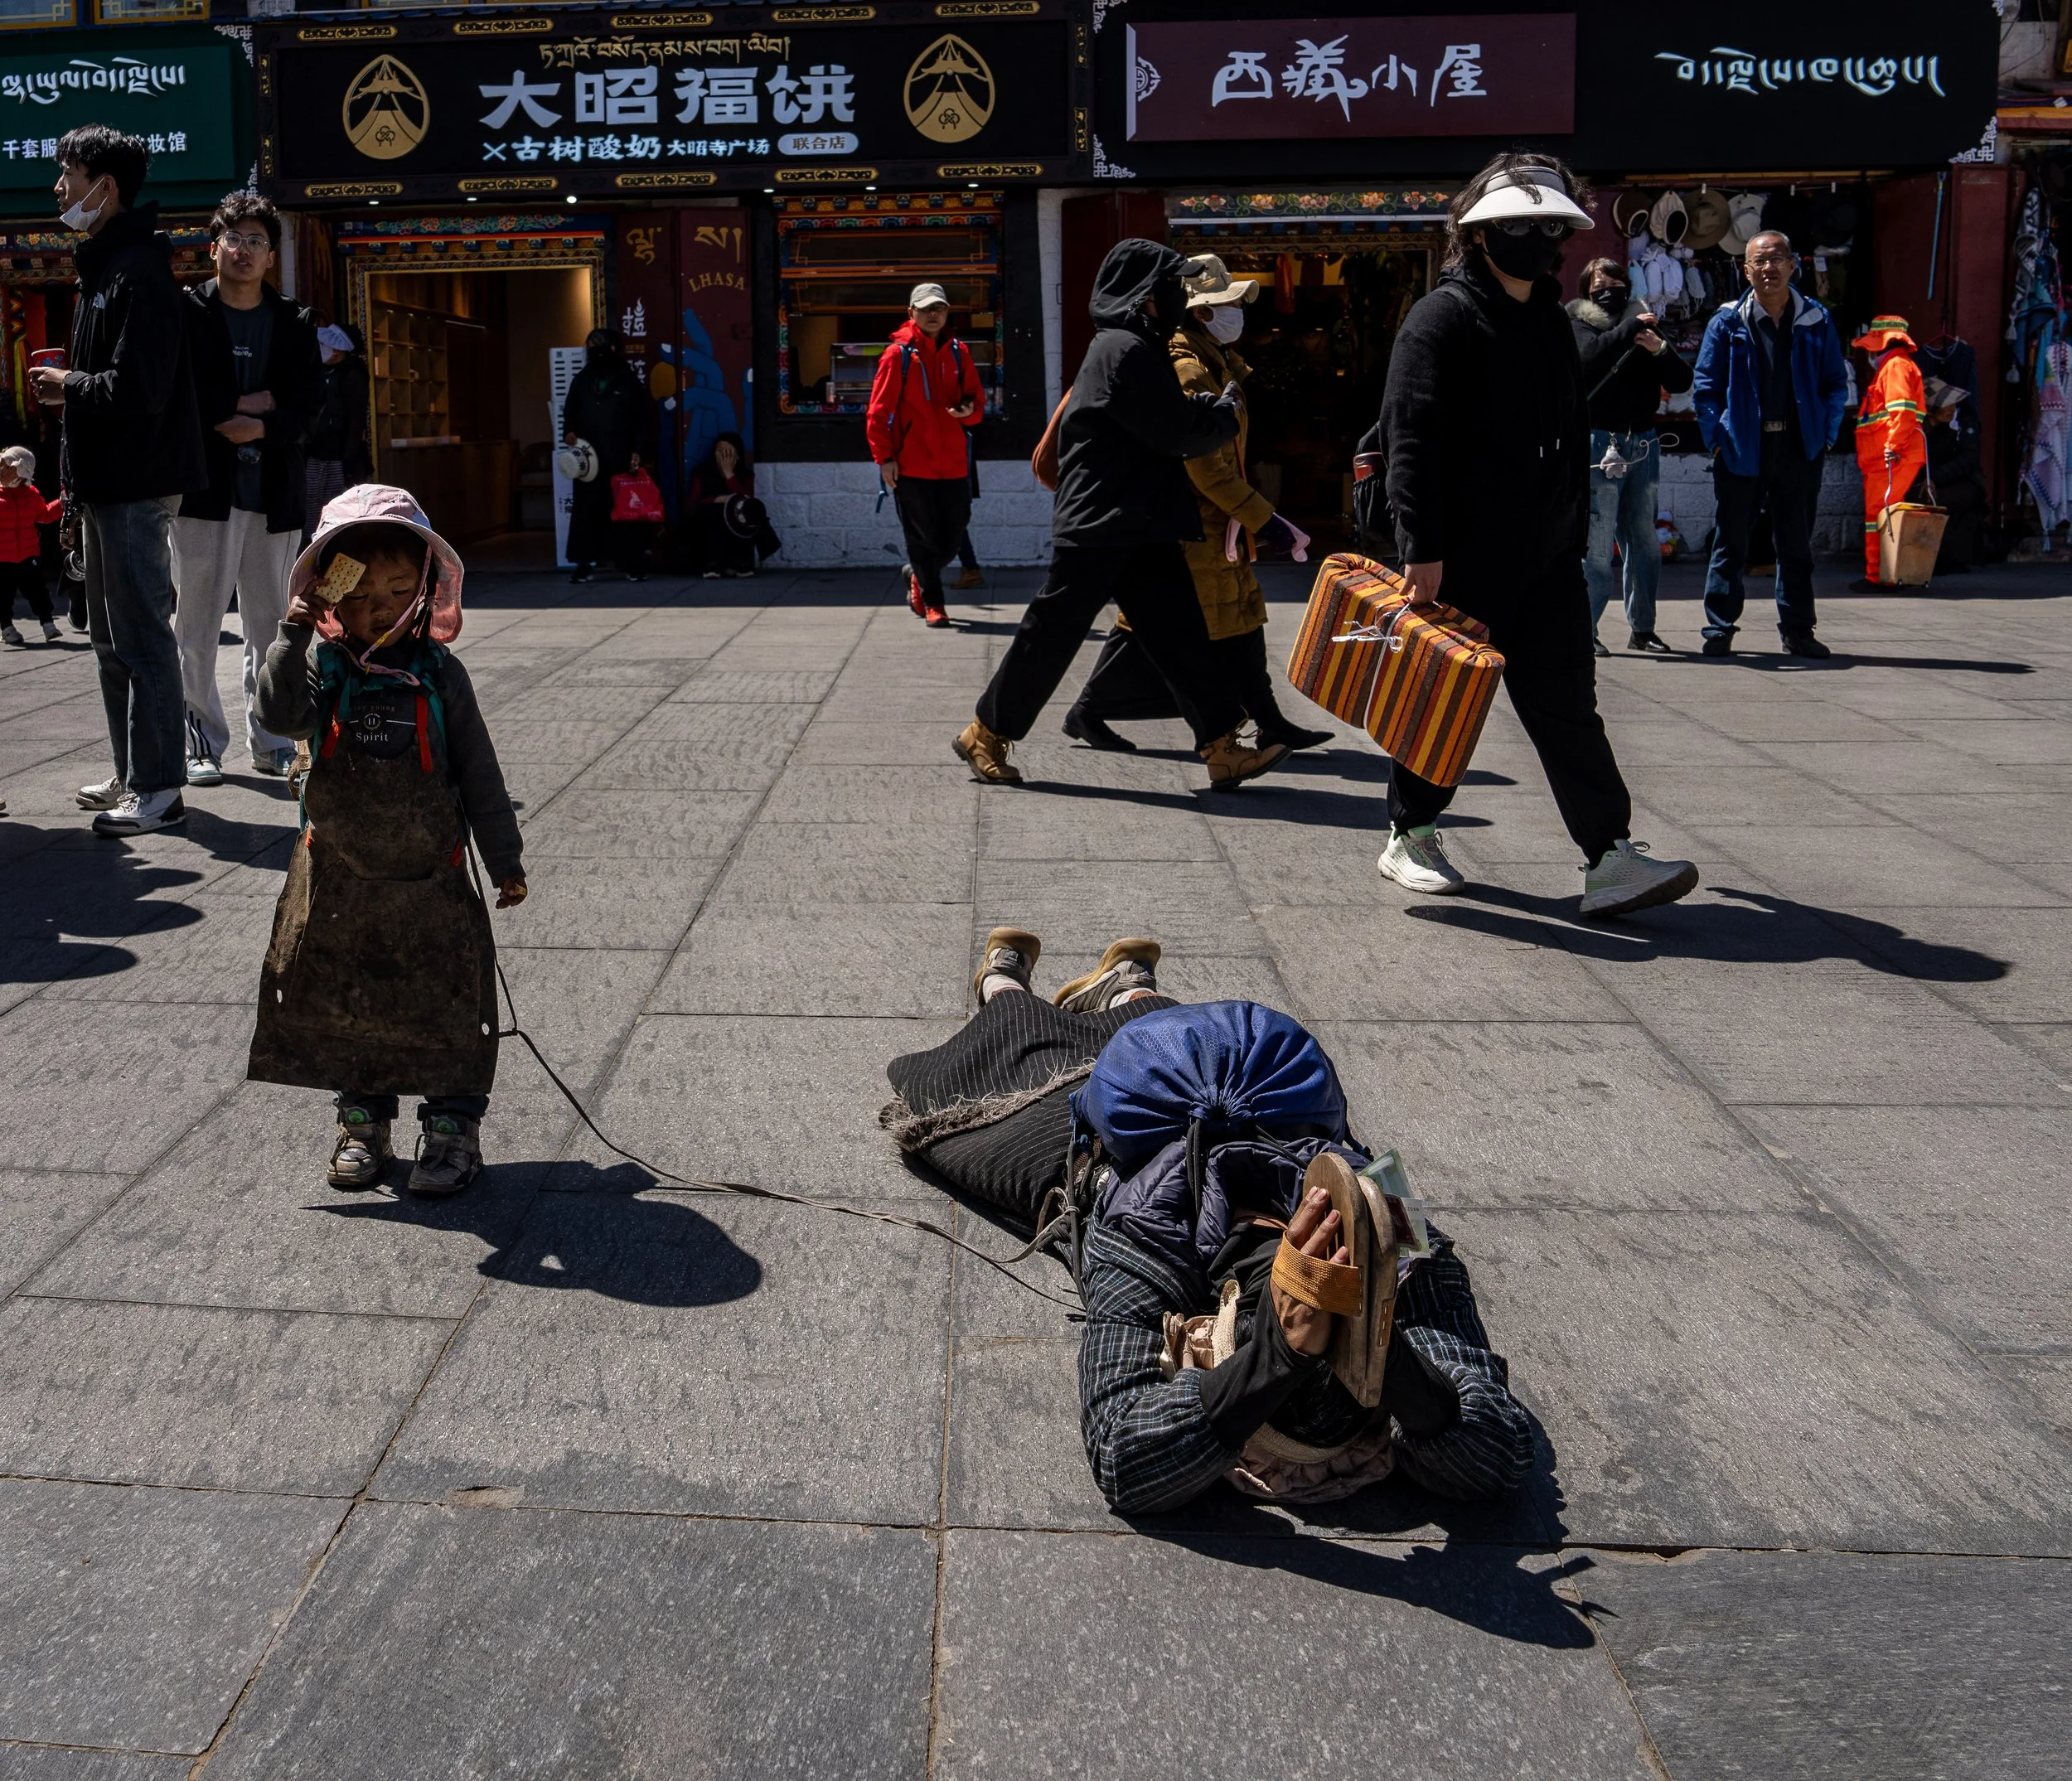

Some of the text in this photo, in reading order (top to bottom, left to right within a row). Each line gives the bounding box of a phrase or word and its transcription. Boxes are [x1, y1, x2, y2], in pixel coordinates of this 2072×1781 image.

[1211, 34, 1489, 123] 西藏小屋
[479, 65, 854, 128] 大昭福饼
[667, 139, 770, 157] 大昭寺广场
[792, 135, 846, 151] 联合店
[690, 272, 745, 292] LHASA
[356, 732, 389, 743] Spirit
